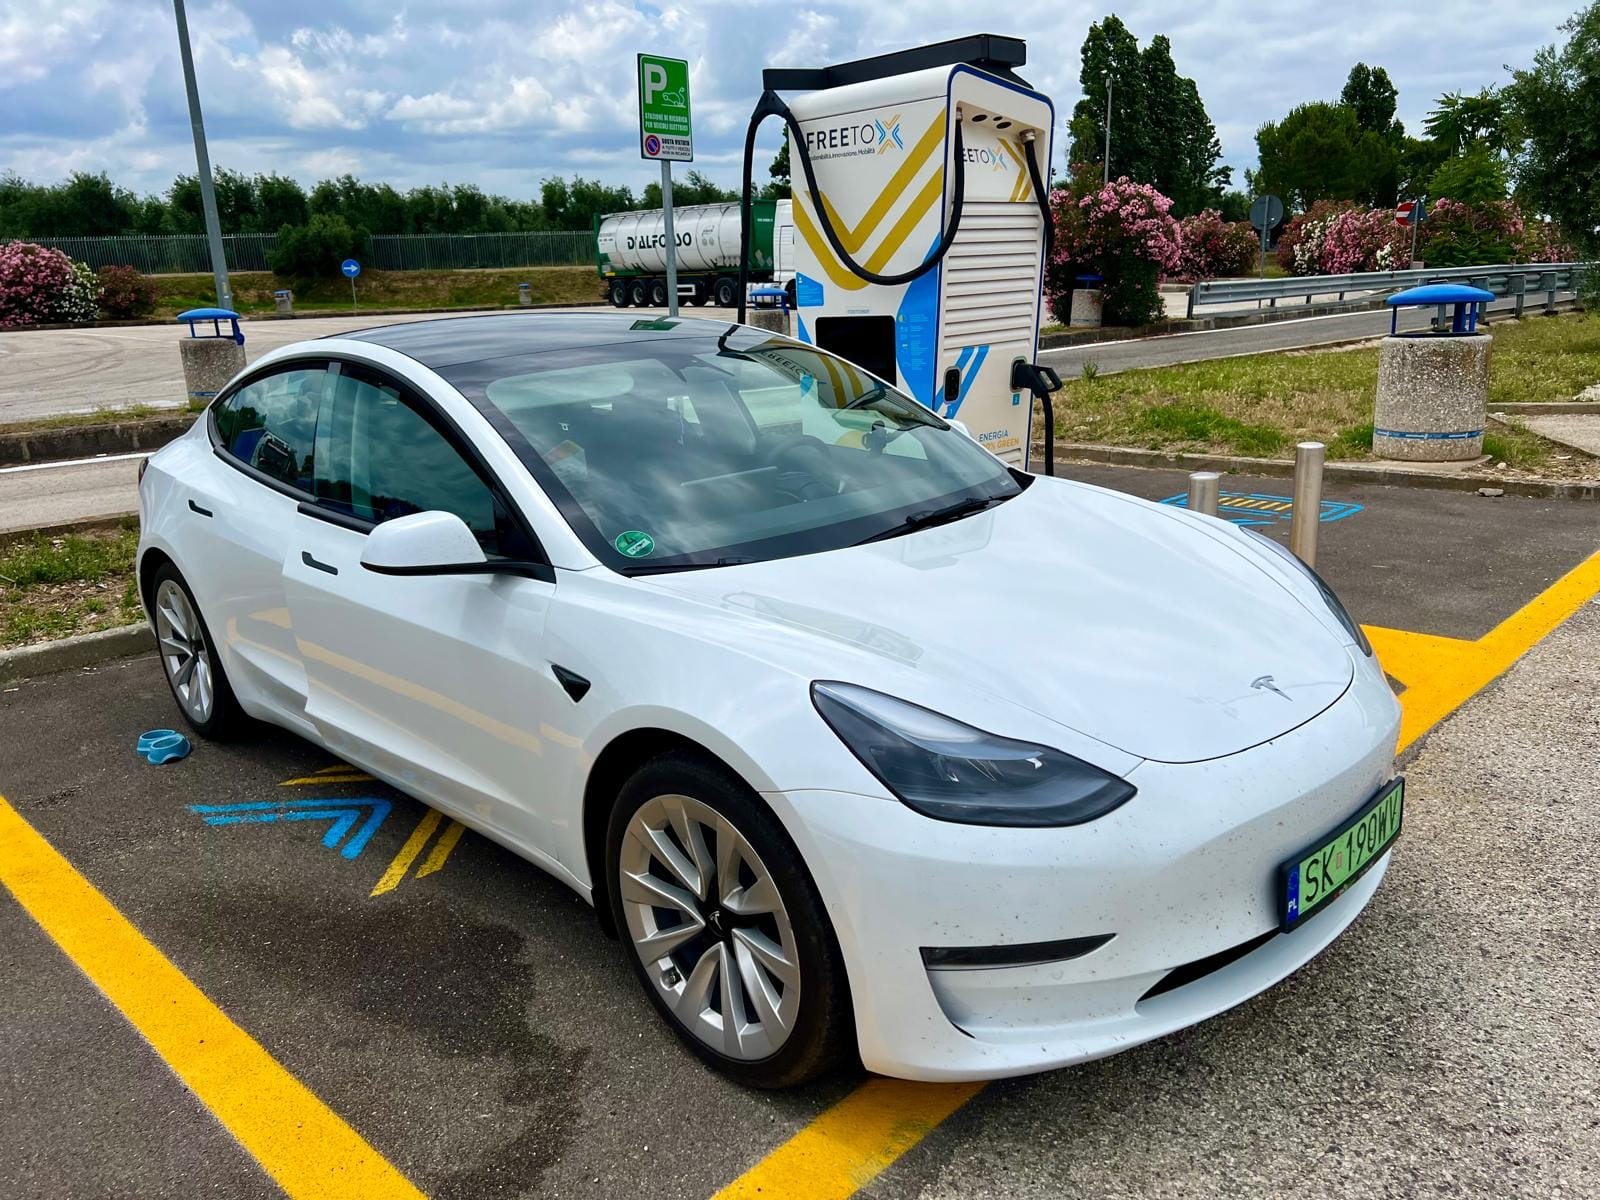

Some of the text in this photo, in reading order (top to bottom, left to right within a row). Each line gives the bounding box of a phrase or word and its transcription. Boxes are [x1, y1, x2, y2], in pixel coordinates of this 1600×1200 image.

[644, 63, 667, 104] P
[979, 430, 1009, 442] ENERGIA
[997, 438, 1019, 448] GREEN
[1305, 790, 1398, 903] SK 190WV
[1288, 898, 1298, 913] PL
